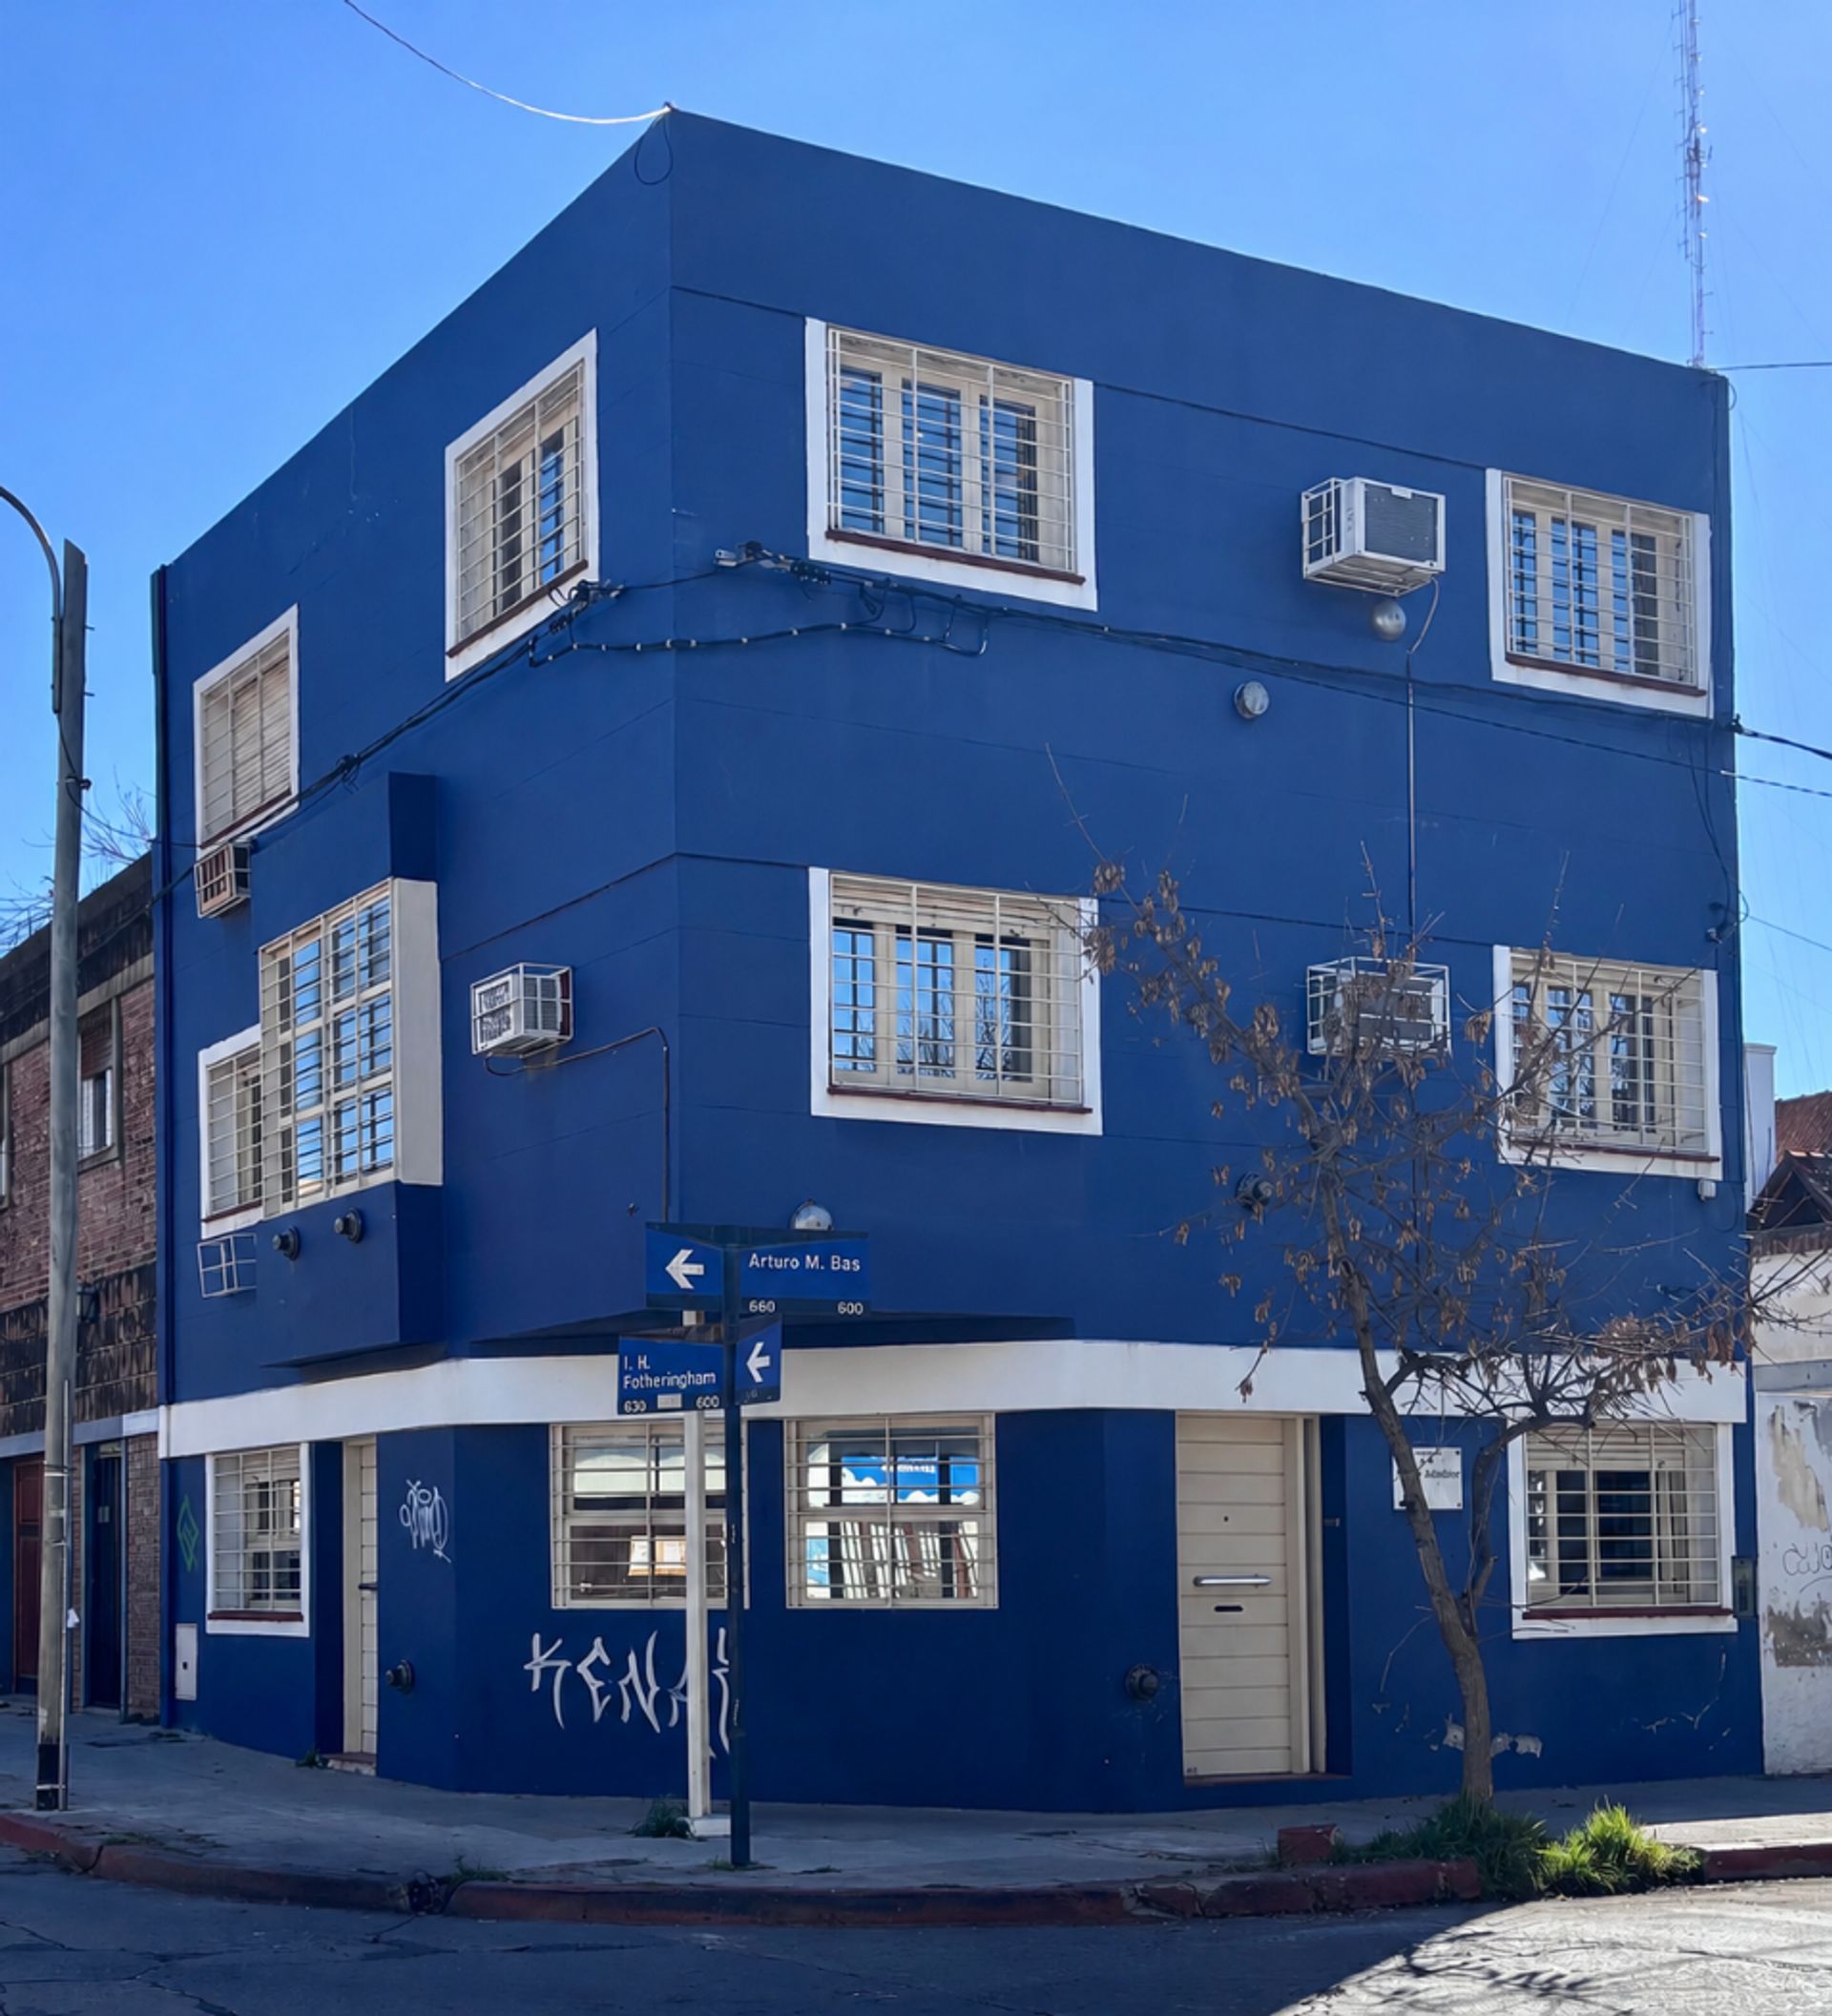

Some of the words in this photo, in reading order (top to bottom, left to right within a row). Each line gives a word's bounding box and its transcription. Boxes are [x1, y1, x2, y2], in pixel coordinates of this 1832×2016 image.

[748, 1252, 801, 1270] Arturo
[804, 1254, 825, 1270] M.
[831, 1255, 861, 1272] Bas
[749, 1299, 776, 1314] 660
[838, 1301, 864, 1315] 600
[623, 1370, 717, 1390] Fotheringham
[624, 1400, 647, 1413] 630
[696, 1395, 720, 1409] 600
